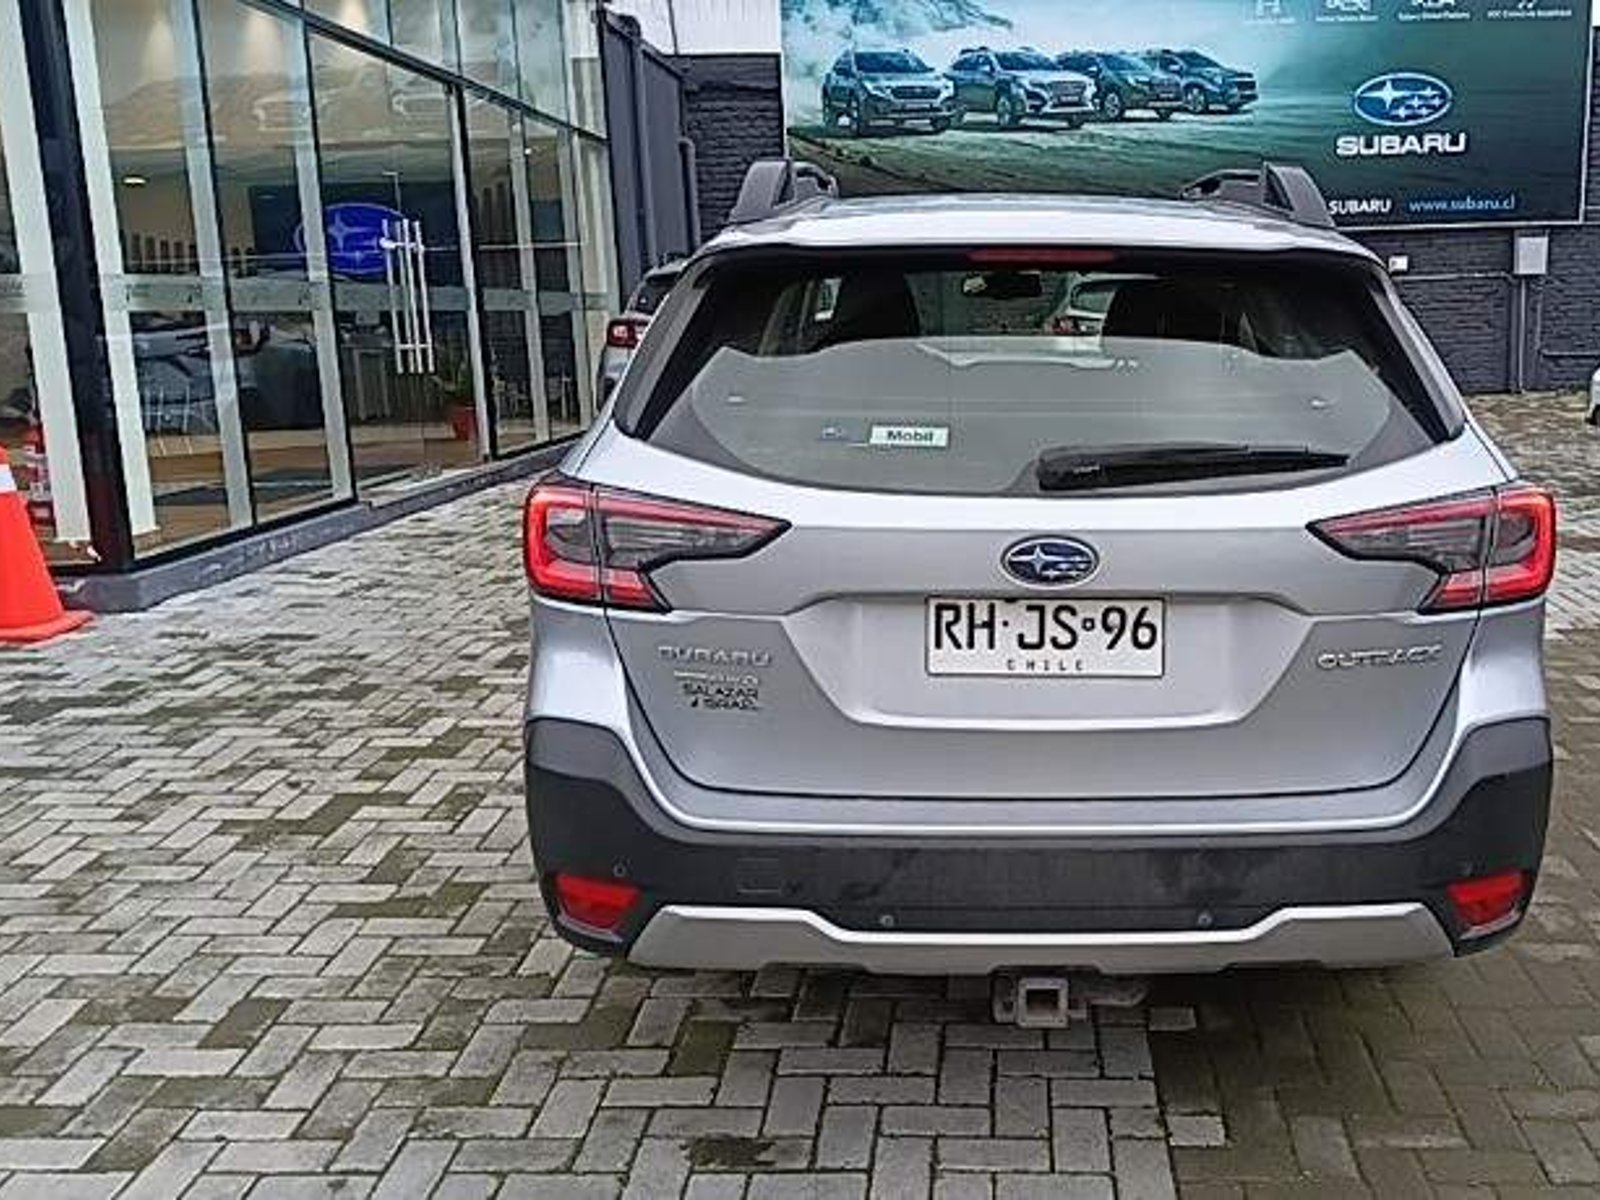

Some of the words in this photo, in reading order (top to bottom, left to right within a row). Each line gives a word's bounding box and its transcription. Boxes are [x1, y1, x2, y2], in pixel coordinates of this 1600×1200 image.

[1335, 132, 1467, 156] SUBARU
[1328, 198, 1392, 215] SUBARU
[1409, 195, 1516, 213] www.subaru.cl
[887, 429, 934, 443] Mobil
[1006, 658, 1084, 672] CHILE
